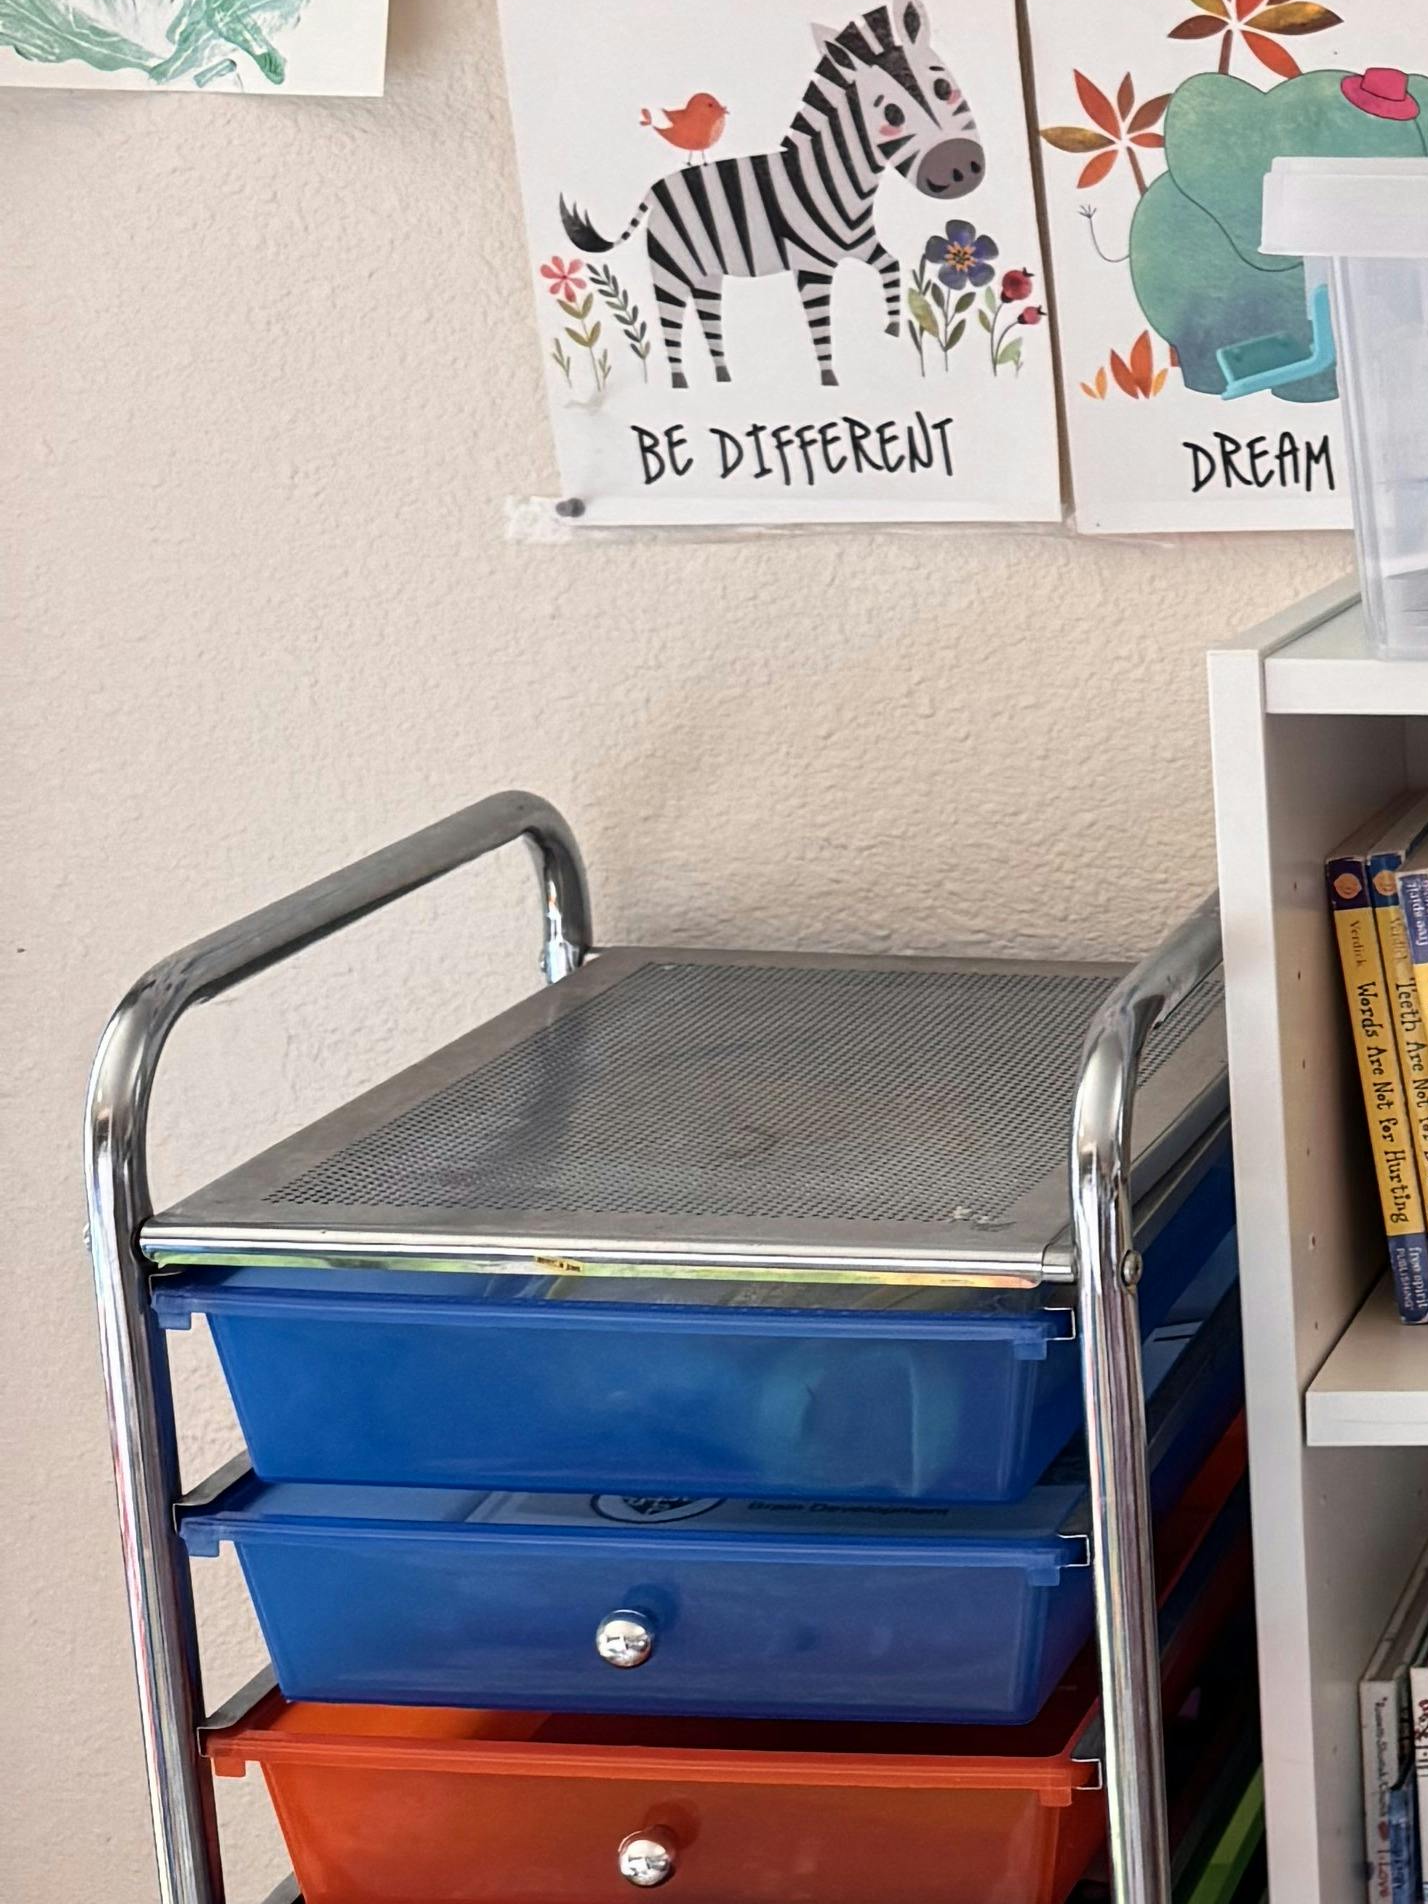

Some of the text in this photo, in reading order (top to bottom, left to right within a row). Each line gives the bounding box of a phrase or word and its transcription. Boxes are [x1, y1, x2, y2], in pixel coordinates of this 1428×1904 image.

[631, 411, 957, 487] BE DIFFERENT
[1183, 430, 1337, 493] DREAM
[1396, 978, 1418, 1033] Teeth
[1356, 982, 1410, 1225] Words Hurting
